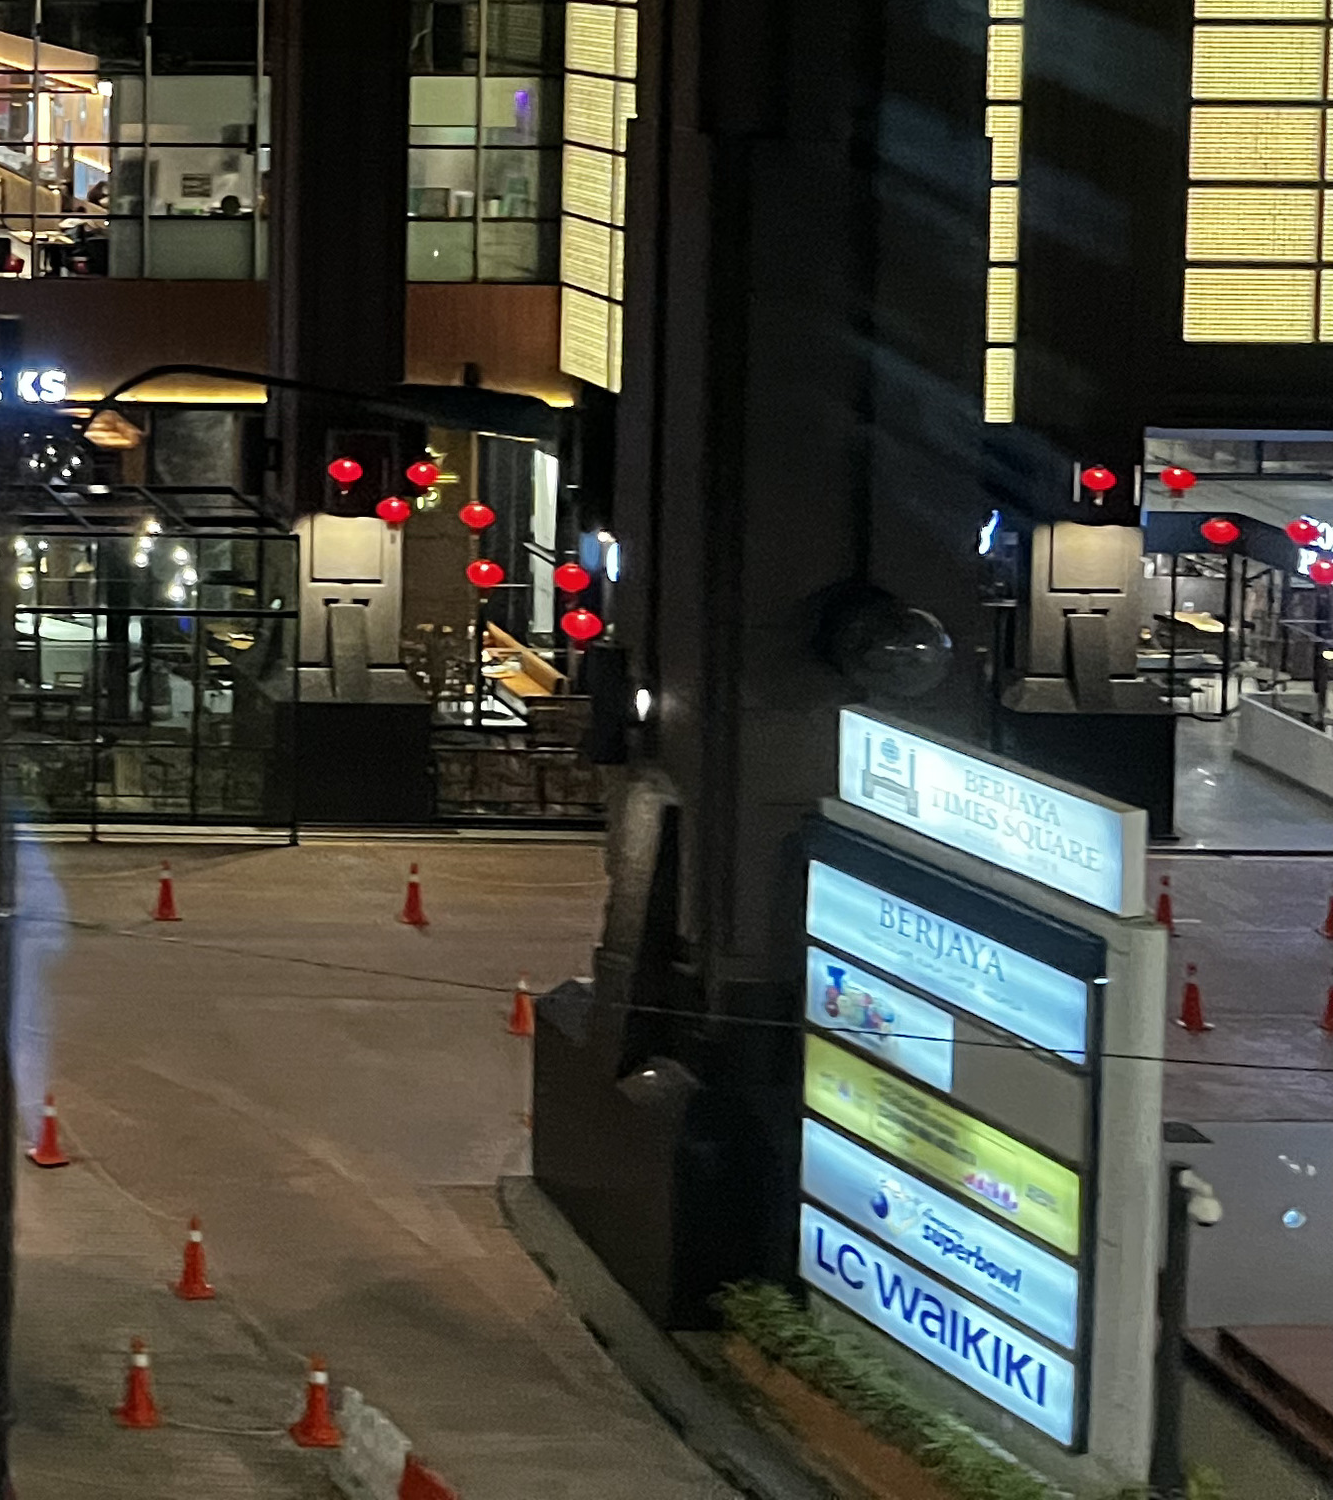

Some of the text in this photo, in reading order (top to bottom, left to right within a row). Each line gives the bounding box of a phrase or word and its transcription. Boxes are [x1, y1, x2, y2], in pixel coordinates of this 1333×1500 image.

[930, 784, 999, 831] TIMES
[1004, 814, 1102, 873] SQUARE
[964, 768, 1061, 826] BERJAYA
[879, 898, 1006, 983] BERJAYA
[816, 1227, 867, 1291] LC
